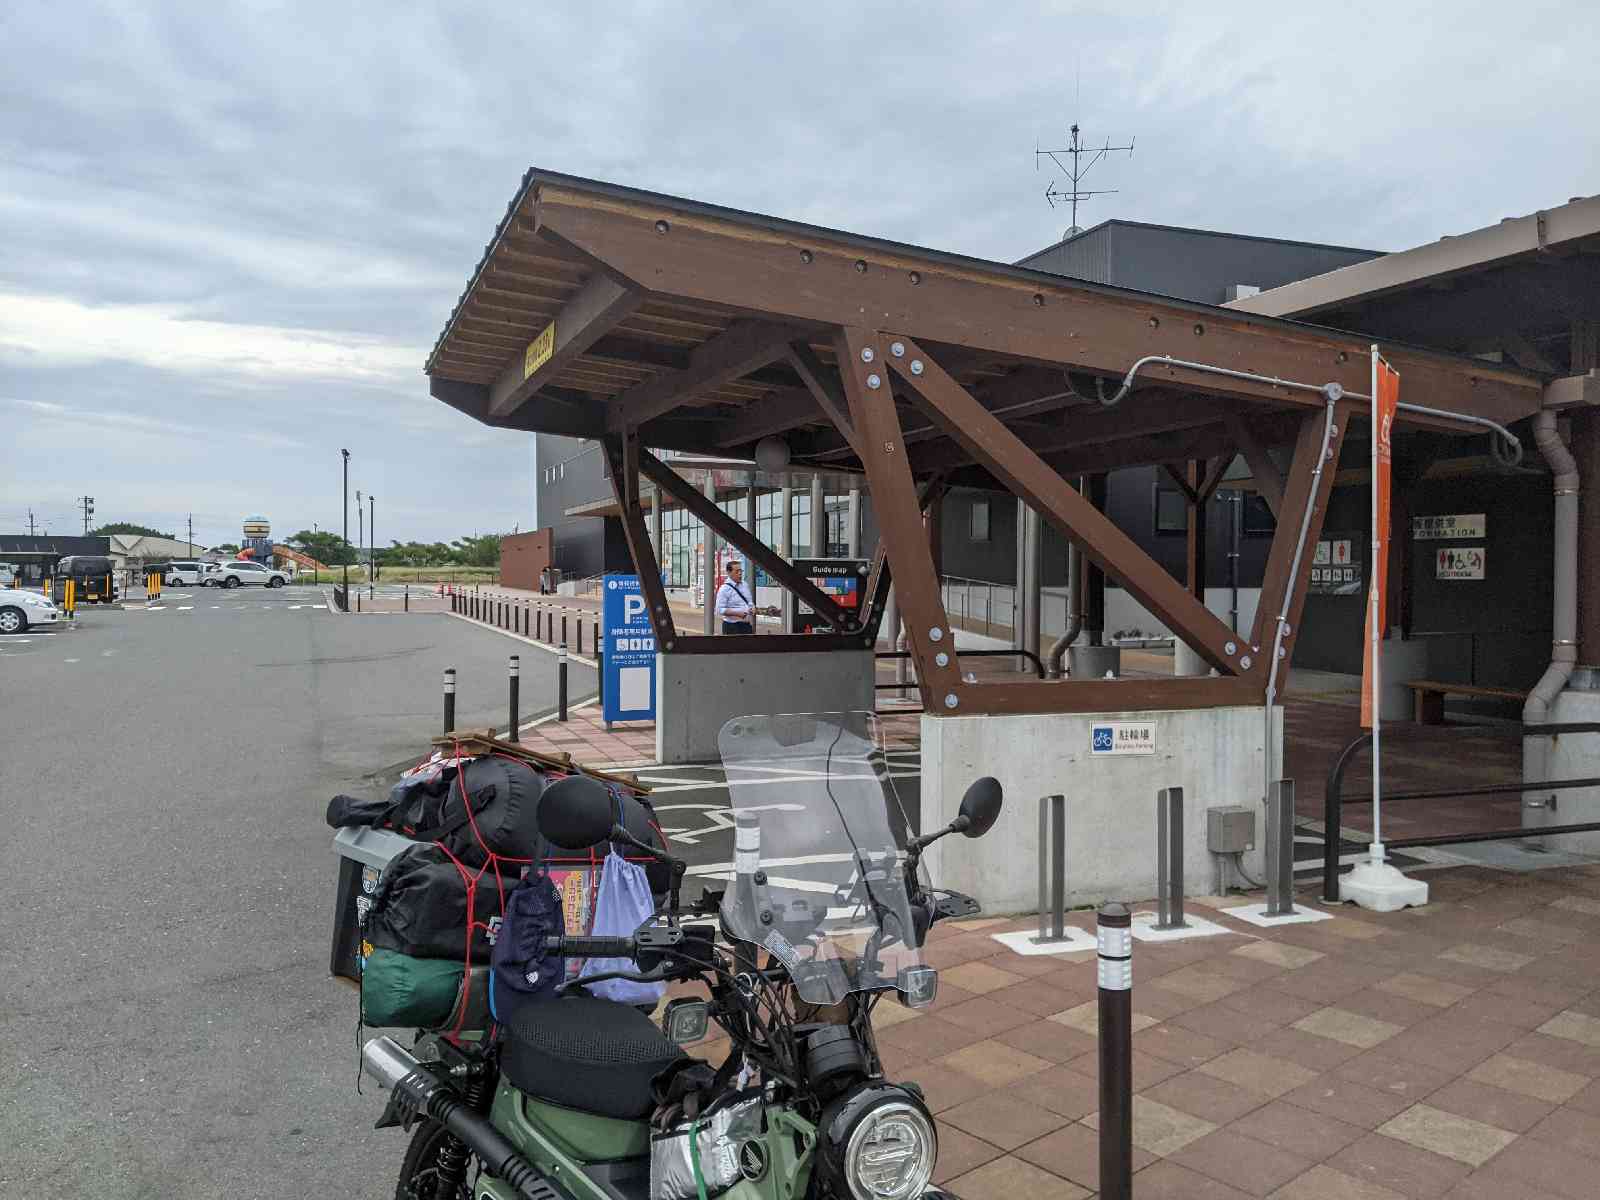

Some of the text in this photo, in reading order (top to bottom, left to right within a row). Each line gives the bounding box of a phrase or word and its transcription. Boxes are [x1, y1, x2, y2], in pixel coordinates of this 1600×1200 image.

[812, 566, 832, 574] Guide
[624, 594, 646, 625] P
[1119, 728, 1150, 741] 駐輪場
